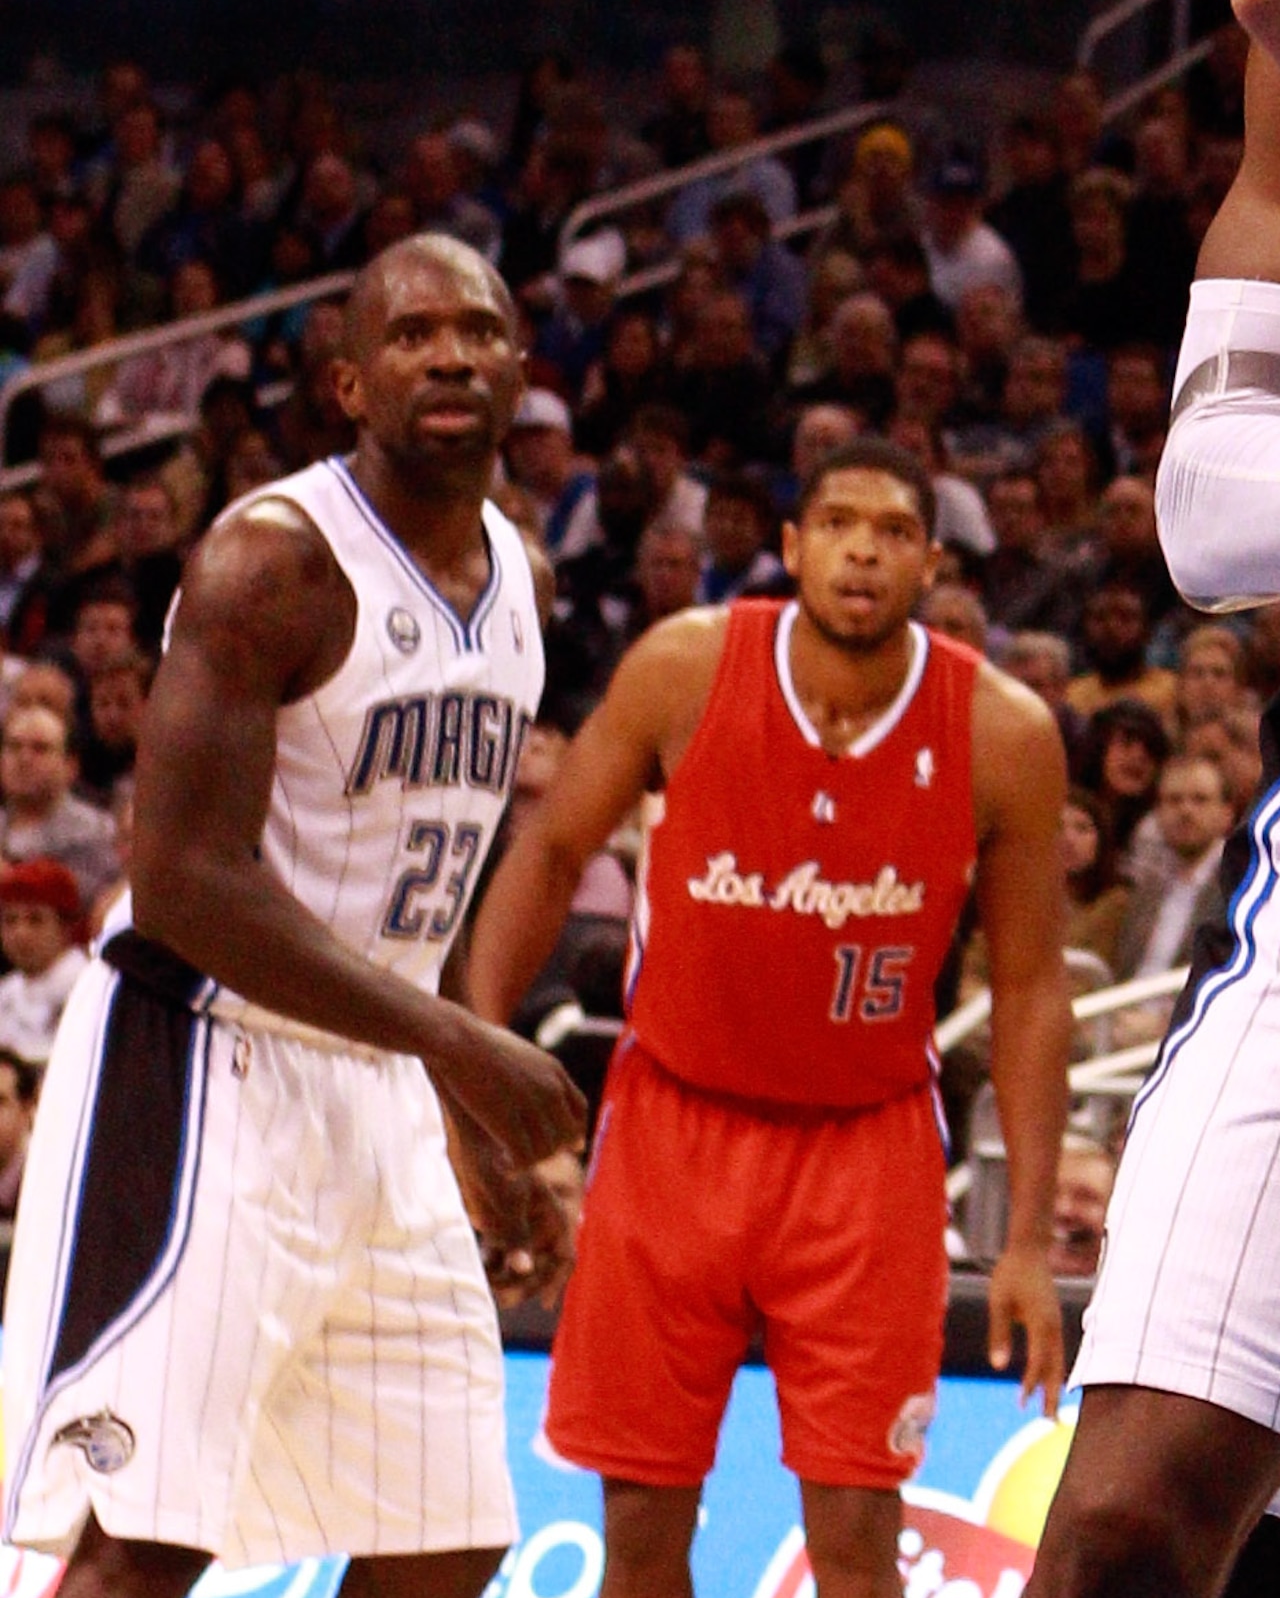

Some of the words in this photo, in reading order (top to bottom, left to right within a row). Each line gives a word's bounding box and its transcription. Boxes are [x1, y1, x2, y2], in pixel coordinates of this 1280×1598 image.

[381, 818, 484, 941] 23
[686, 849, 765, 907] Los
[769, 858, 927, 930] Angeles
[830, 942, 915, 1023] 15
